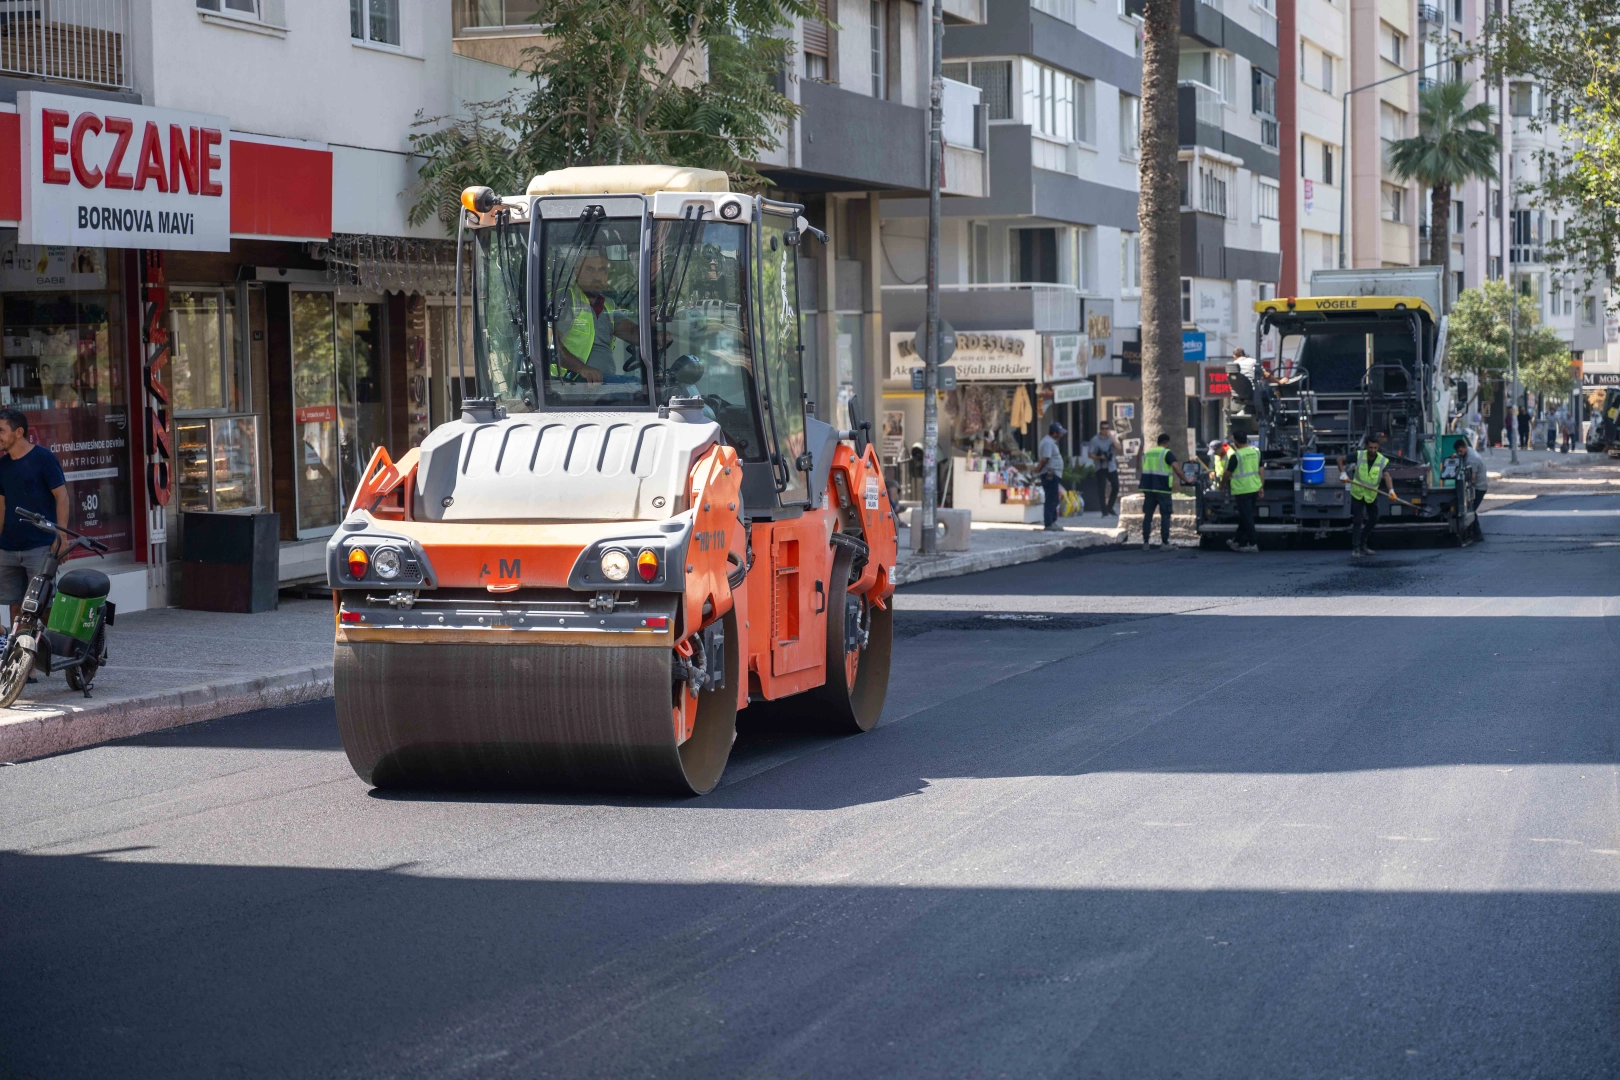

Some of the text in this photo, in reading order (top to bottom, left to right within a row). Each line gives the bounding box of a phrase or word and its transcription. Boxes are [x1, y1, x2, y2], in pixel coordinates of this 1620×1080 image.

[42, 107, 223, 197] ECZANE
[78, 205, 154, 233] BORNOVA
[1315, 299, 1357, 309] VÖGELE
[956, 365, 986, 377] Şifalı
[989, 363, 1032, 375] Bitkiler
